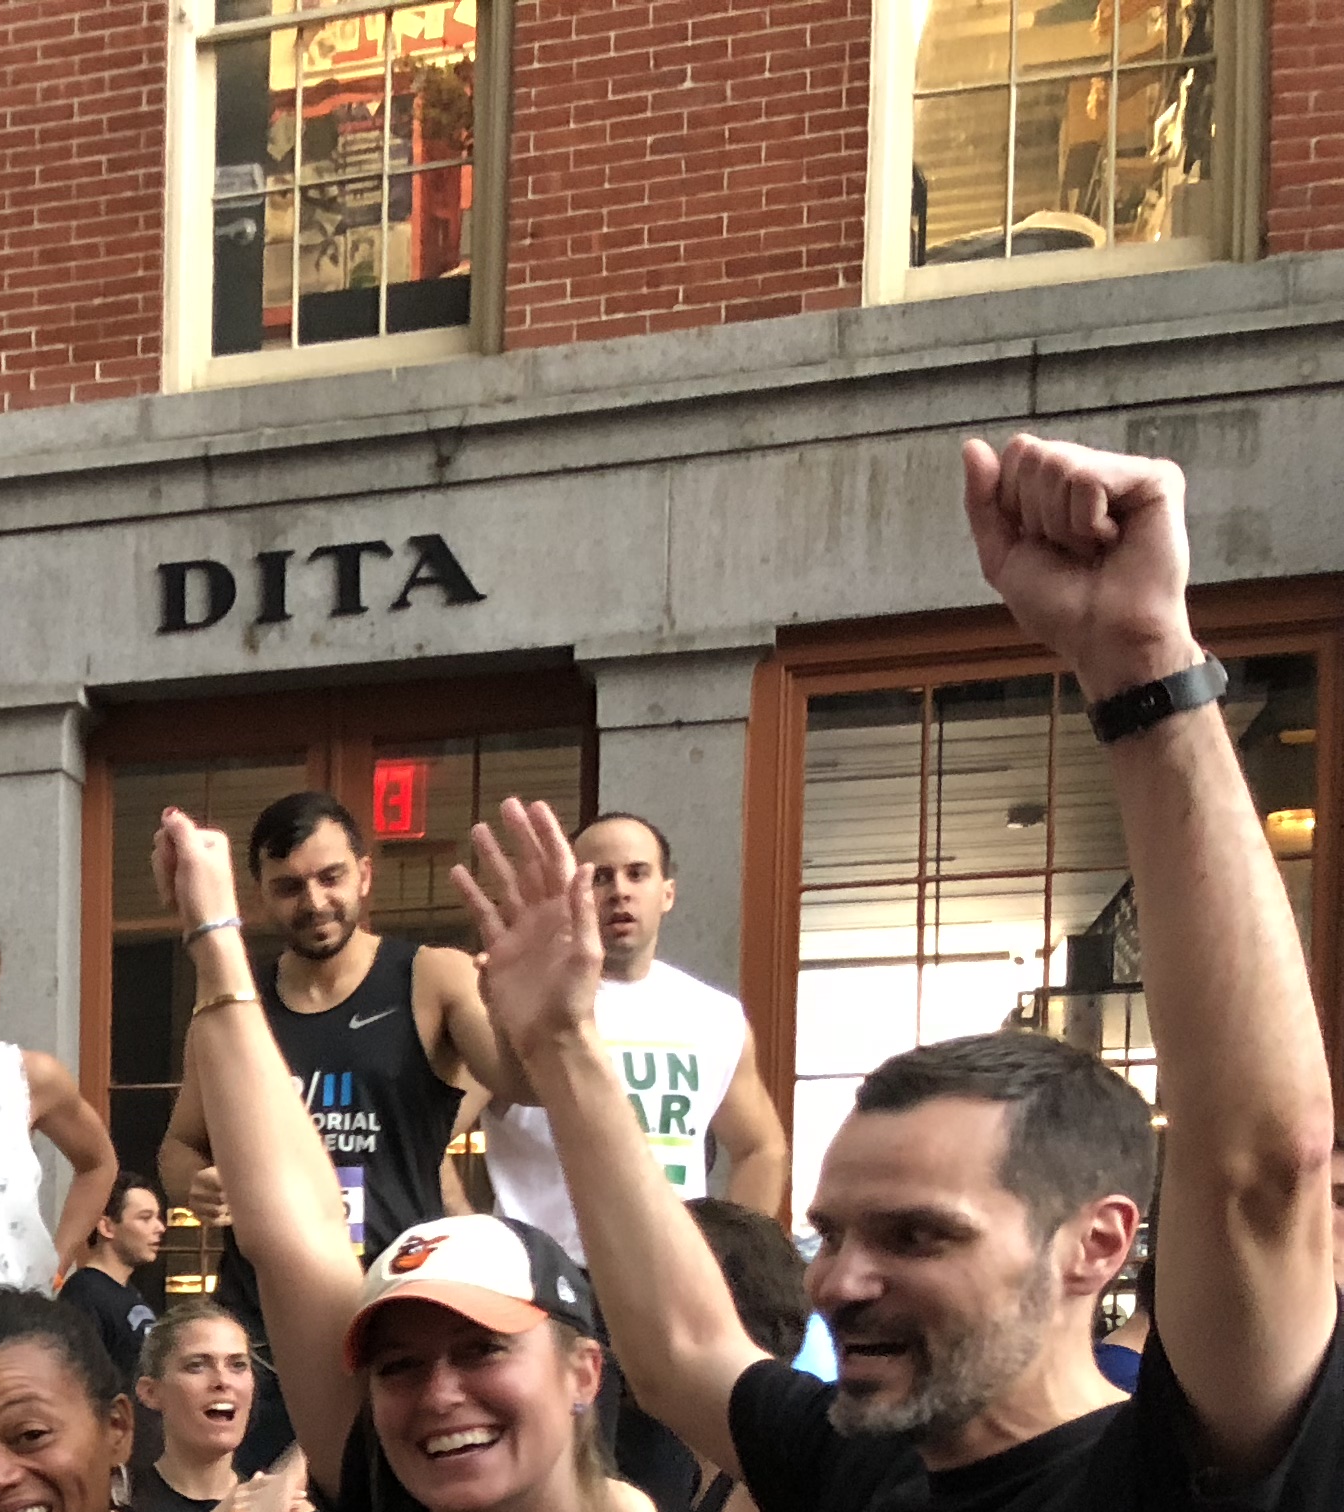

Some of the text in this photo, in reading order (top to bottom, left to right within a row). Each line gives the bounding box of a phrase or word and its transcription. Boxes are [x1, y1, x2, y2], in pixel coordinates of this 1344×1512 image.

[156, 533, 488, 634] DITA
[622, 1051, 699, 1092] UN
[312, 1112, 382, 1132] ORIAL
[325, 1133, 377, 1153] EUM
